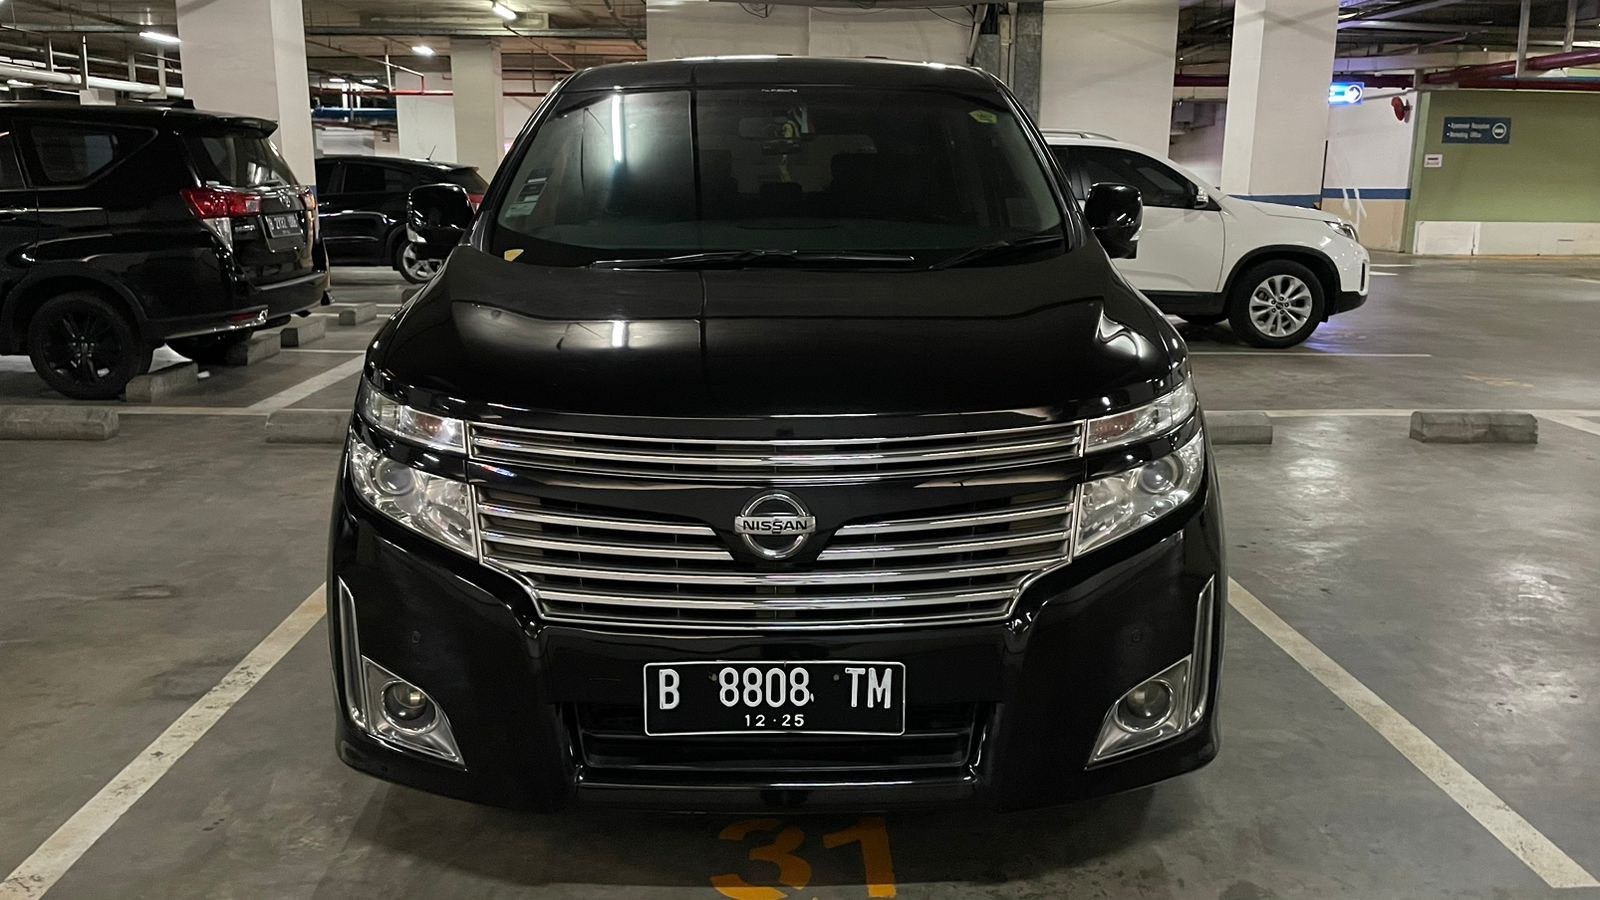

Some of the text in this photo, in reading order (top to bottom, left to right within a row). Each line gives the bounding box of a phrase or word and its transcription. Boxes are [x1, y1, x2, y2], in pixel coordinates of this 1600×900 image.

[743, 520, 807, 531] NISSAN
[658, 667, 892, 709] B 8808 TM
[709, 816, 897, 900] 31
